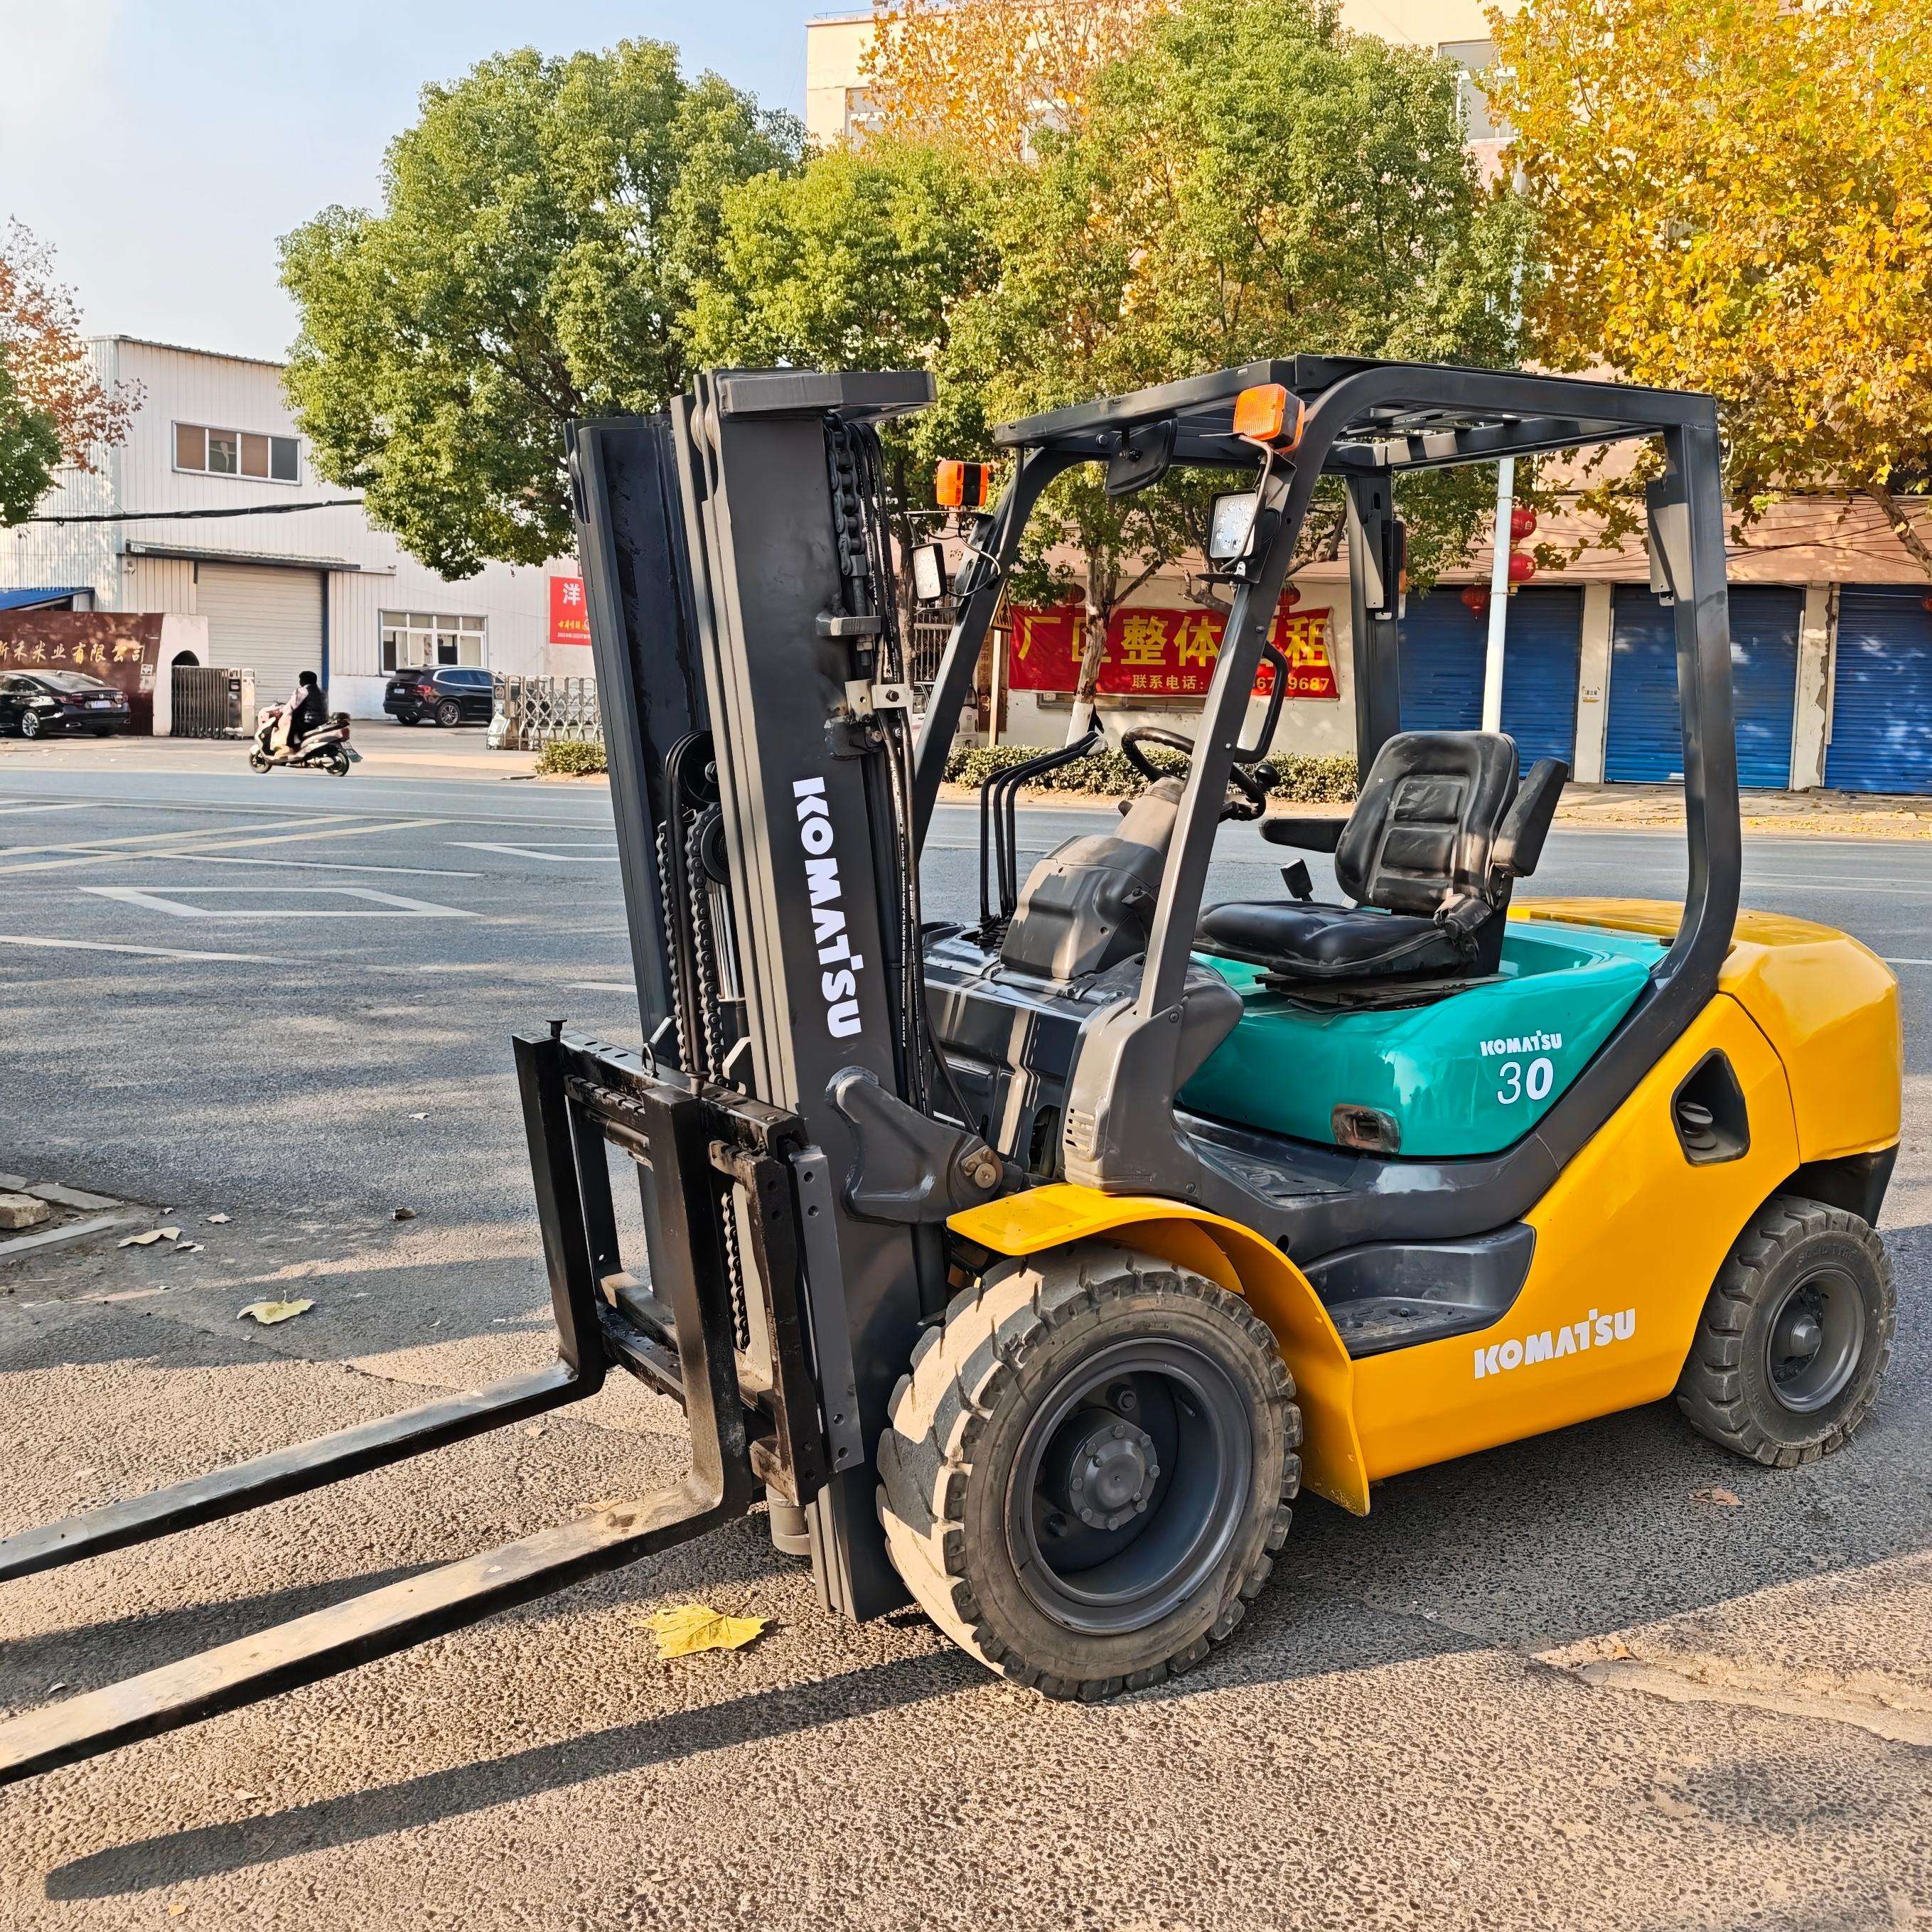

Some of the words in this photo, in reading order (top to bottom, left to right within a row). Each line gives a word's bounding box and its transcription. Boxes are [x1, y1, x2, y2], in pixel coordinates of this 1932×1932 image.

[563, 583, 581, 606] 洋
[1018, 614, 1330, 667] 厂区整体租
[793, 776, 864, 1039] KOMATSU
[1480, 1030, 1562, 1056] KOMATSU
[1497, 1057, 1554, 1105] 30
[1474, 1308, 1636, 1380] KOMATSU
